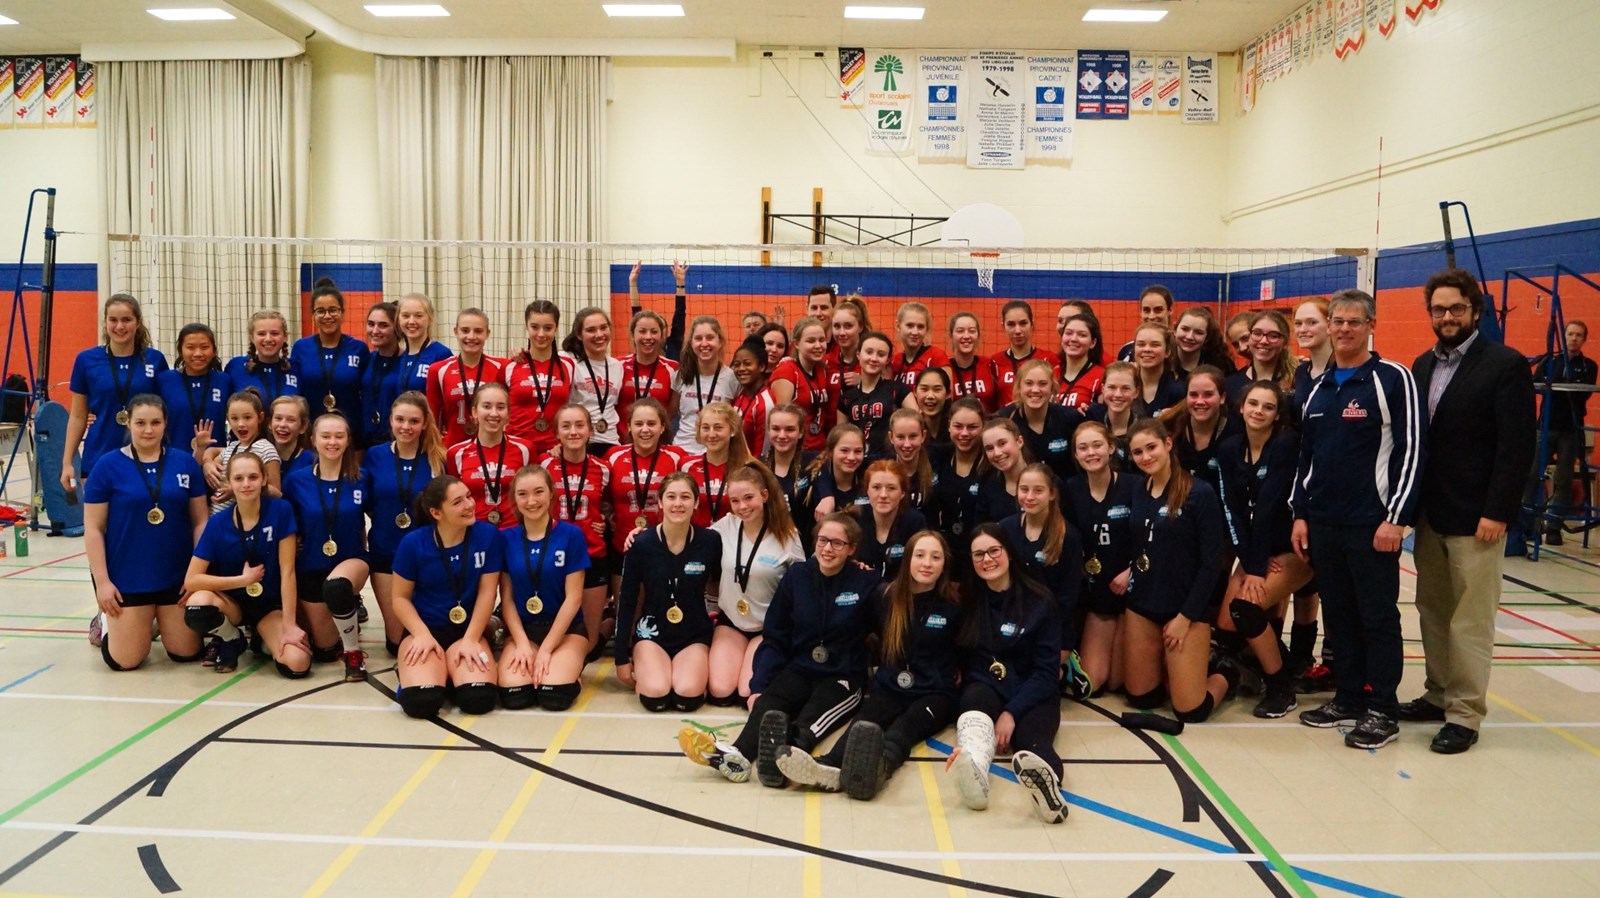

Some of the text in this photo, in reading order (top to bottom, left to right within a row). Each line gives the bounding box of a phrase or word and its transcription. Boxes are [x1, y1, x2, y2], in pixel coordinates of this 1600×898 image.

[926, 72, 960, 80] JUVÉNILE
[145, 364, 155, 378] 5
[416, 363, 430, 379] 15
[285, 373, 298, 388] 12
[212, 388, 222, 402] 2
[176, 473, 190, 489] 13
[353, 489, 363, 505] 9
[627, 489, 659, 513] 12
[19, 530, 27, 539] G
[262, 526, 273, 542] 7
[474, 551, 486, 569] 11
[554, 550, 566, 568] 3
